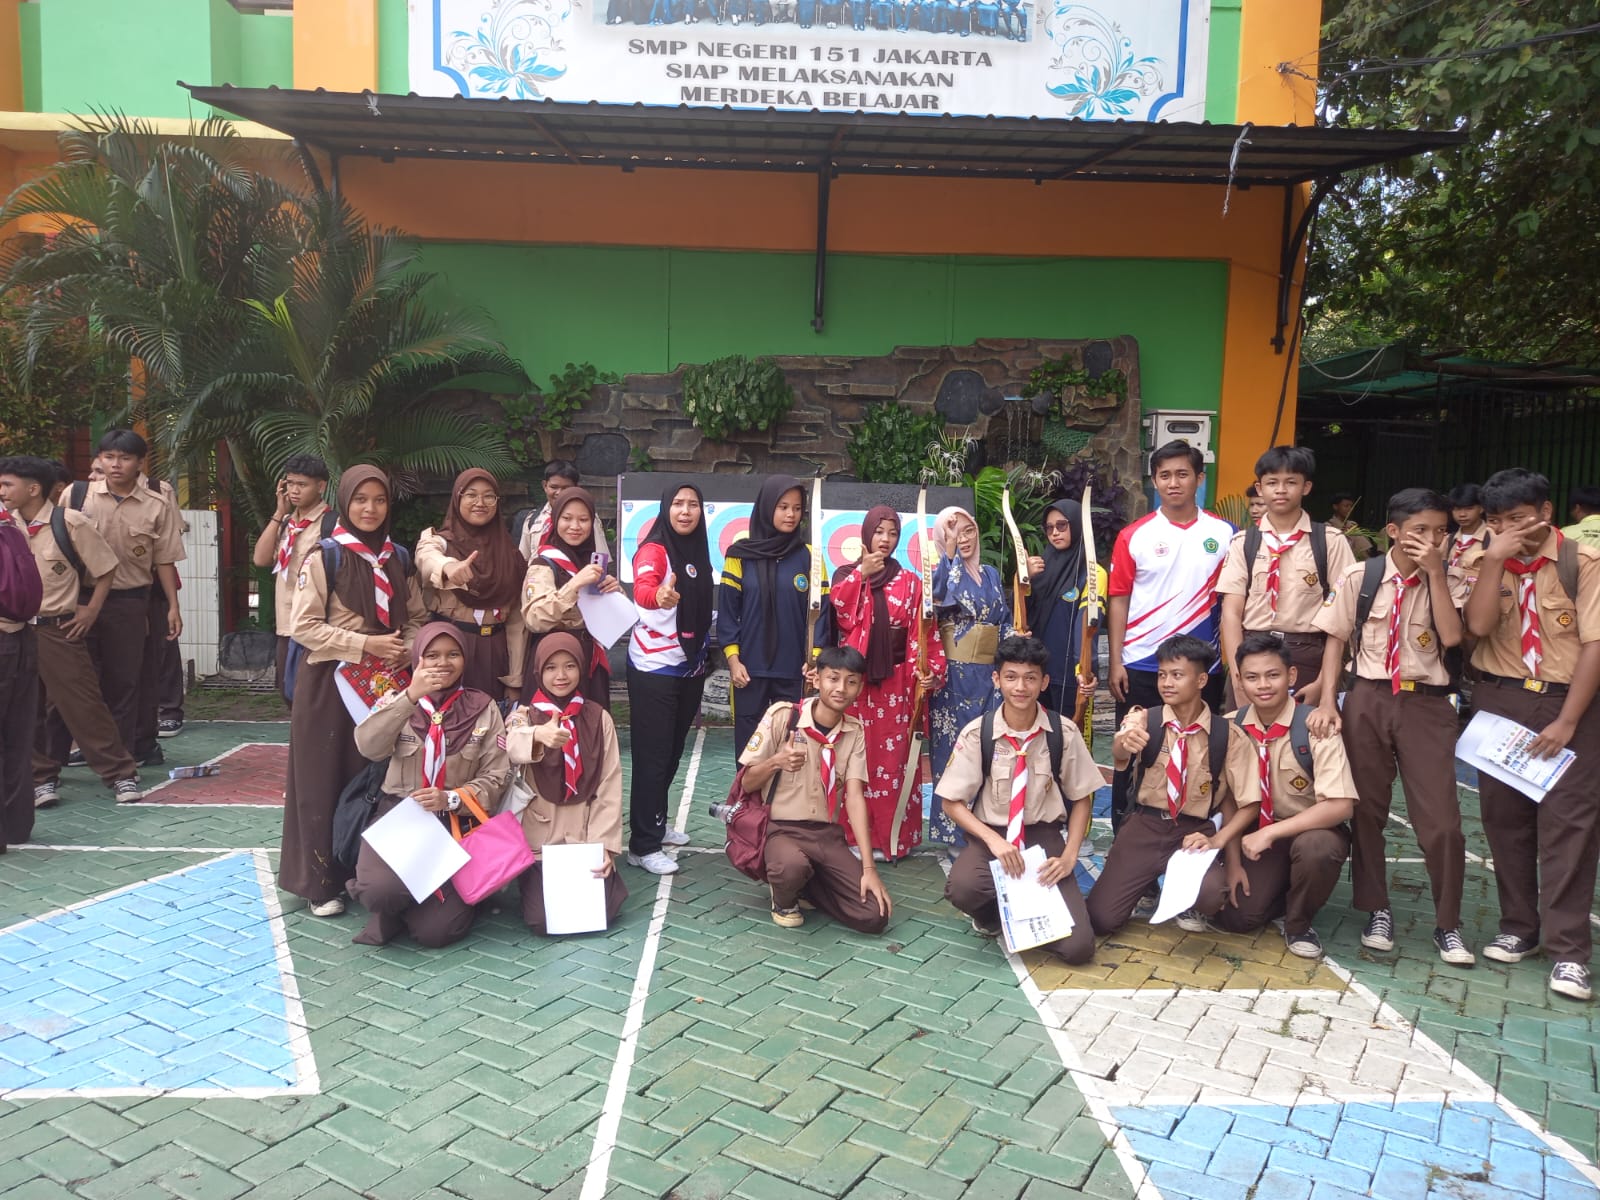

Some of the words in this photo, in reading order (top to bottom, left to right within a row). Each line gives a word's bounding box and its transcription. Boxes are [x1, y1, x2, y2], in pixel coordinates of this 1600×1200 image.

[628, 38, 688, 56] SMP
[697, 41, 797, 61] NEGERI
[809, 46, 860, 63] 151
[873, 48, 993, 67] JAKARTA
[666, 63, 729, 80] SIAP
[738, 65, 954, 88] MELAKSANAKAN
[680, 86, 814, 106] MERDEKA
[823, 91, 940, 110] BELAJAR
[923, 556, 931, 597] CARTEL
[1088, 560, 1098, 603] CARTEL
